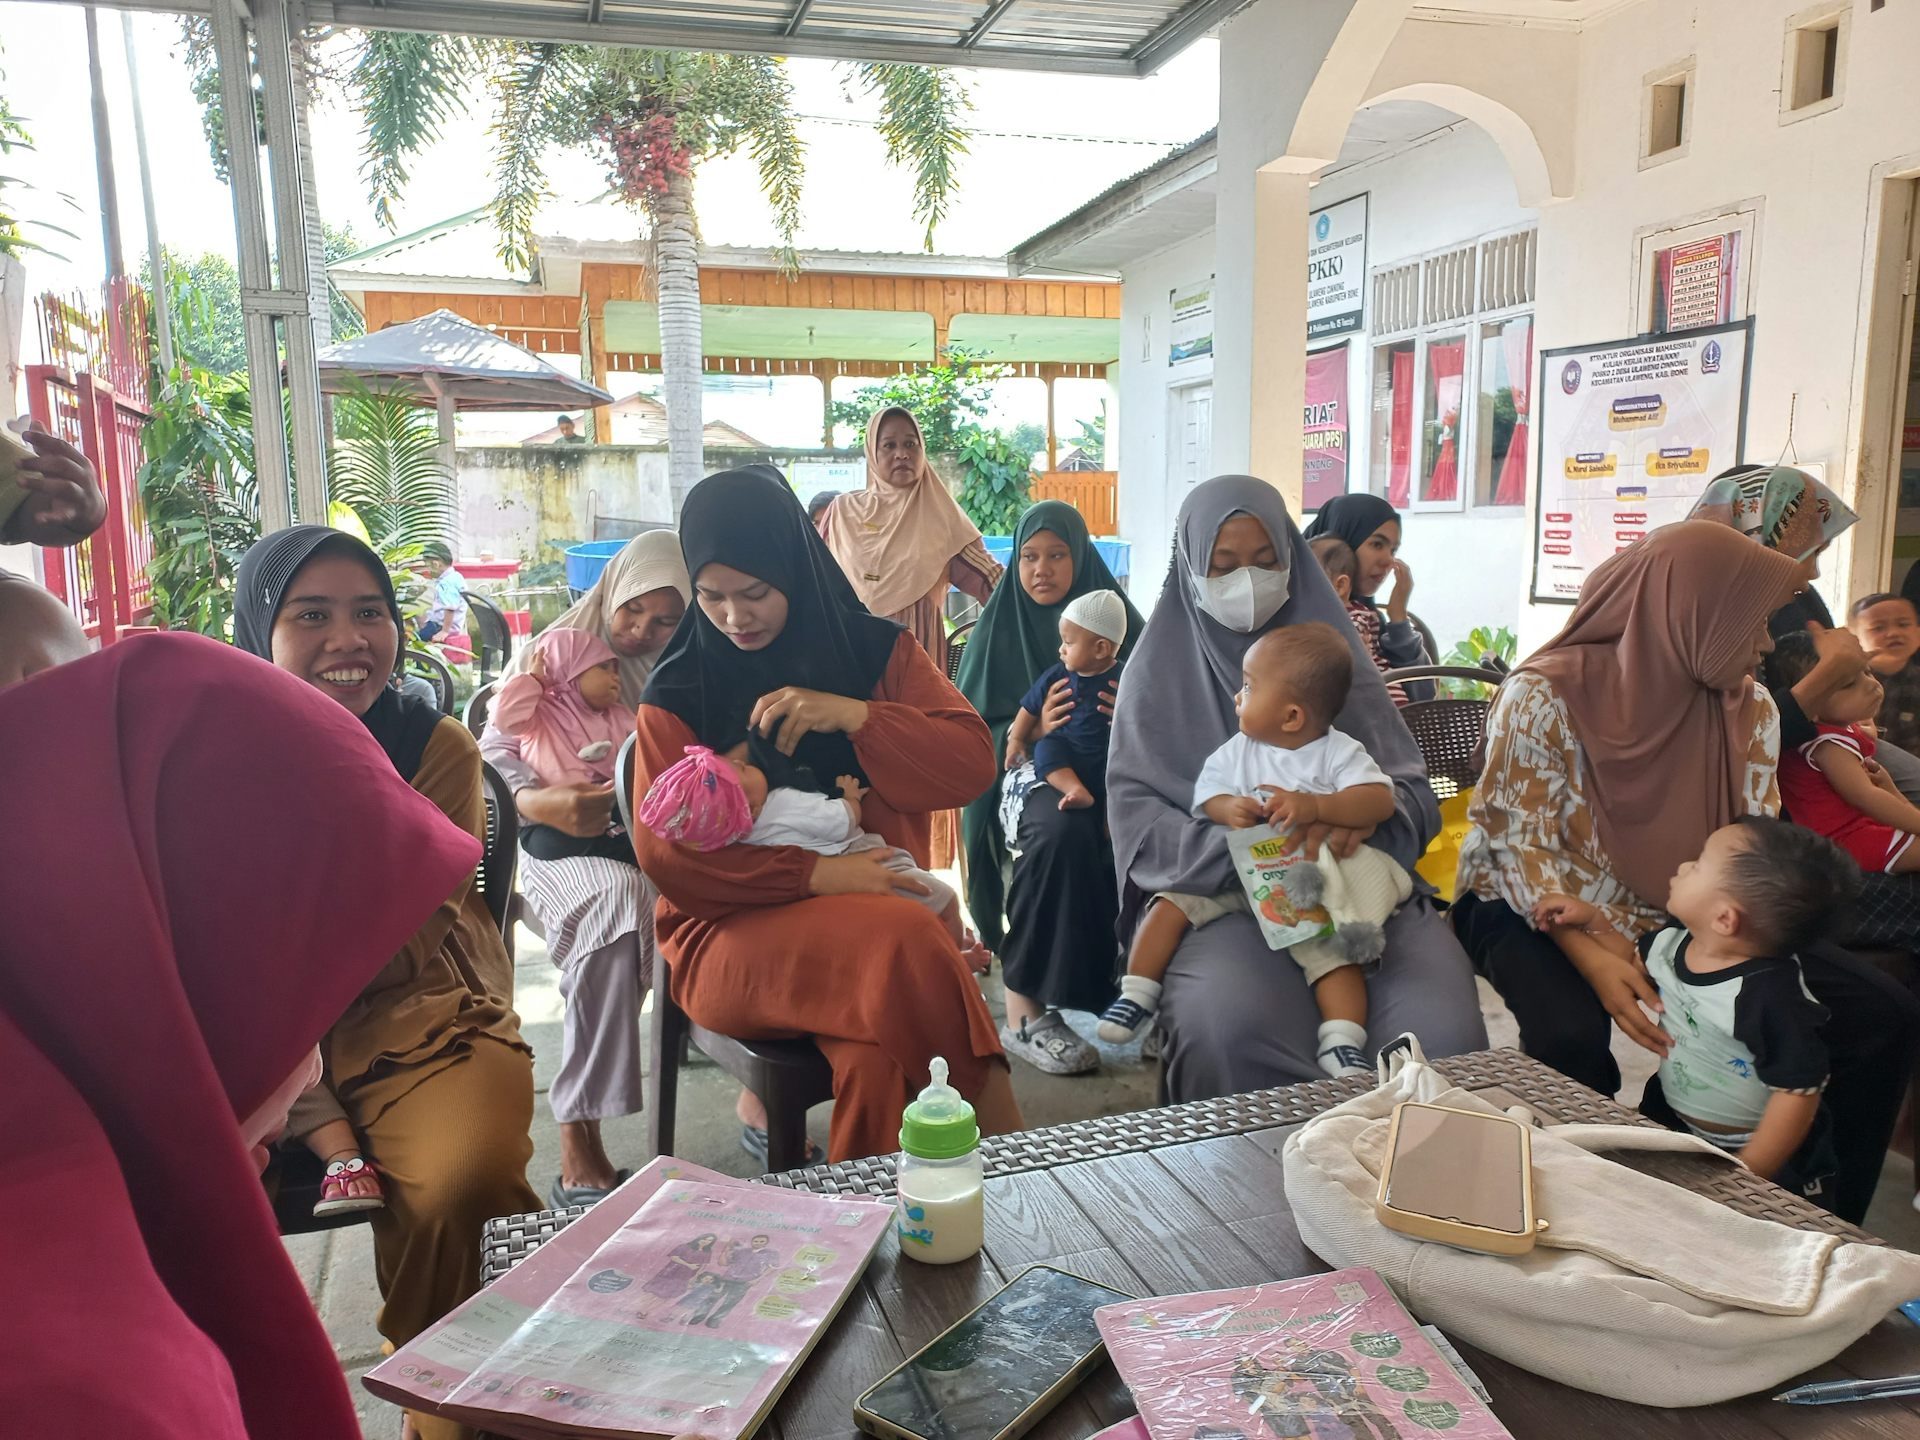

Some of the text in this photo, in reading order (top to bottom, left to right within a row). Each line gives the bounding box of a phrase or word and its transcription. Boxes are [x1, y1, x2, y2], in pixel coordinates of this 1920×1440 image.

[1590, 351, 1619, 362] STRUKTUR
[1619, 347, 1655, 359] ORGANISASI
[1623, 357, 1642, 365] KERJA
[1615, 367, 1630, 375] DESA
[1591, 376, 1624, 387] KECAMATAN
[1670, 368, 1689, 377] BONE
